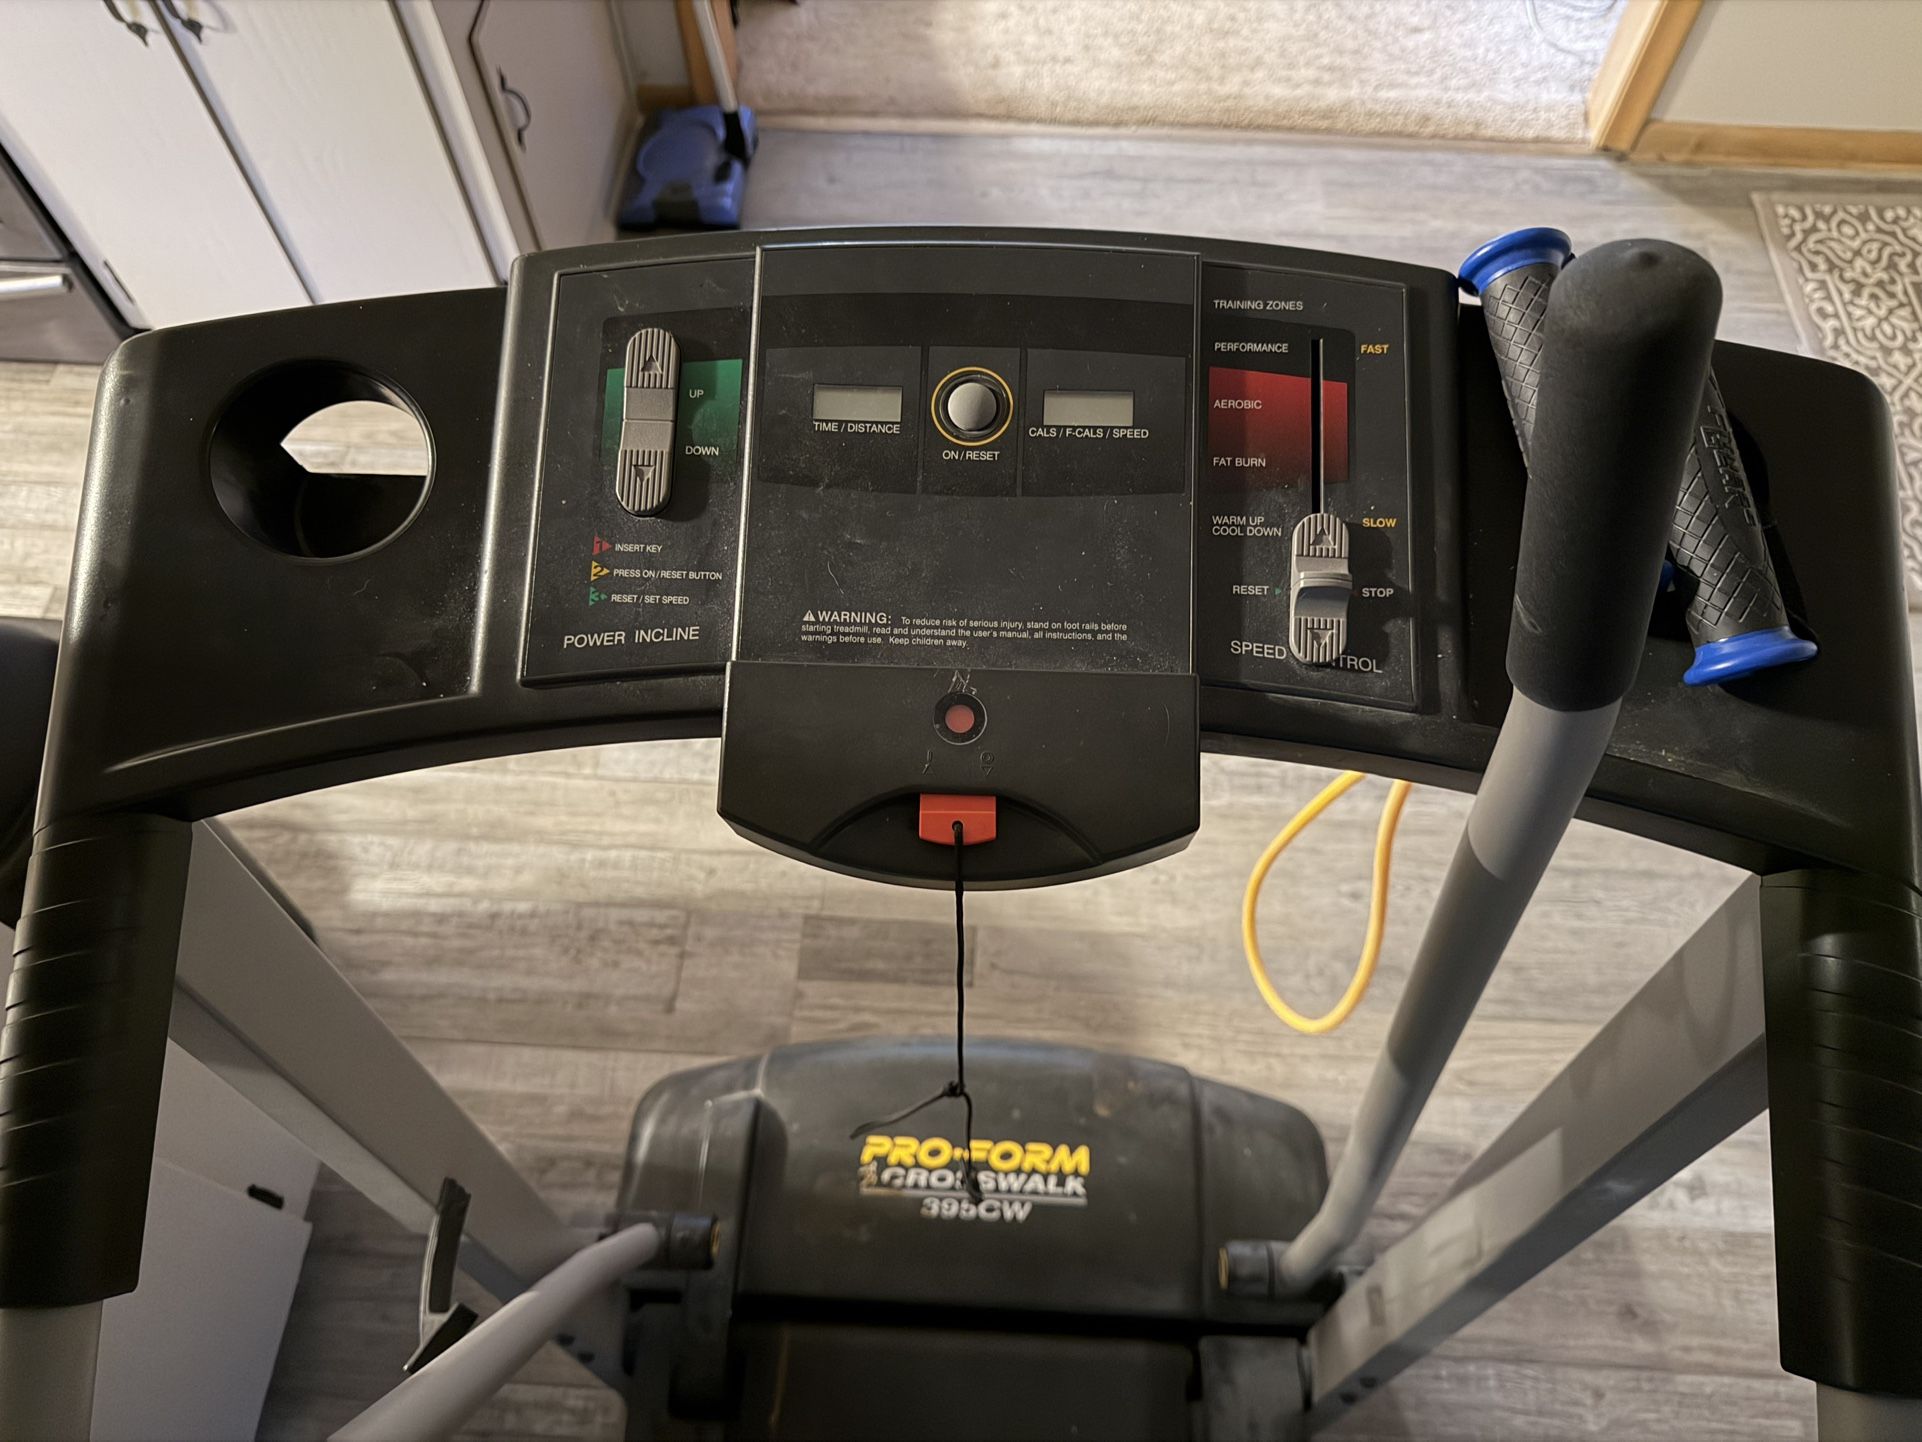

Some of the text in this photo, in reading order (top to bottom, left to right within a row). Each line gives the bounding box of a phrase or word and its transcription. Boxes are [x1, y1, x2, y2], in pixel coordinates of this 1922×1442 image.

[1213, 300, 1304, 311] TRAINING ZONES
[1214, 342, 1289, 354] PERFORMANCE
[1360, 344, 1390, 354] FAST
[688, 389, 705, 399] UP
[1213, 399, 1263, 410] AEROBIC
[813, 422, 839, 432] TIME
[847, 423, 901, 435] DISTANCE
[1028, 427, 1057, 438] CALS
[1065, 428, 1104, 439] F-CALS
[1112, 429, 1149, 440] SPEED
[685, 446, 719, 456] DOWN
[1212, 457, 1267, 468] FAT BURN
[1212, 515, 1265, 526] WARM UP
[1362, 517, 1397, 529] SLOW
[1212, 526, 1282, 538] COOL DOWN
[614, 543, 645, 553] INSERT
[646, 544, 663, 554] KEY
[613, 568, 641, 578] PRESS
[688, 571, 723, 581] BUTTON
[1232, 585, 1270, 595] RESET
[1362, 588, 1394, 598] STOP
[611, 593, 639, 604] RESET
[644, 595, 661, 605] SET
[662, 596, 690, 606] SPEED
[817, 609, 1128, 632] WARNING: To reduce risk of serious injury, stand on foot rails before
[563, 626, 700, 649] POWER INCLINE
[801, 624, 1128, 642] starting treadmill, read and understand the user's manual, all instructions, and the
[801, 634, 838, 645] warnings
[839, 634, 866, 644] before
[888, 636, 911, 646] Keep
[911, 637, 944, 646] children
[946, 639, 969, 650] away.
[1230, 640, 1288, 660] SPEED
[920, 1196, 1034, 1224] 395CW
